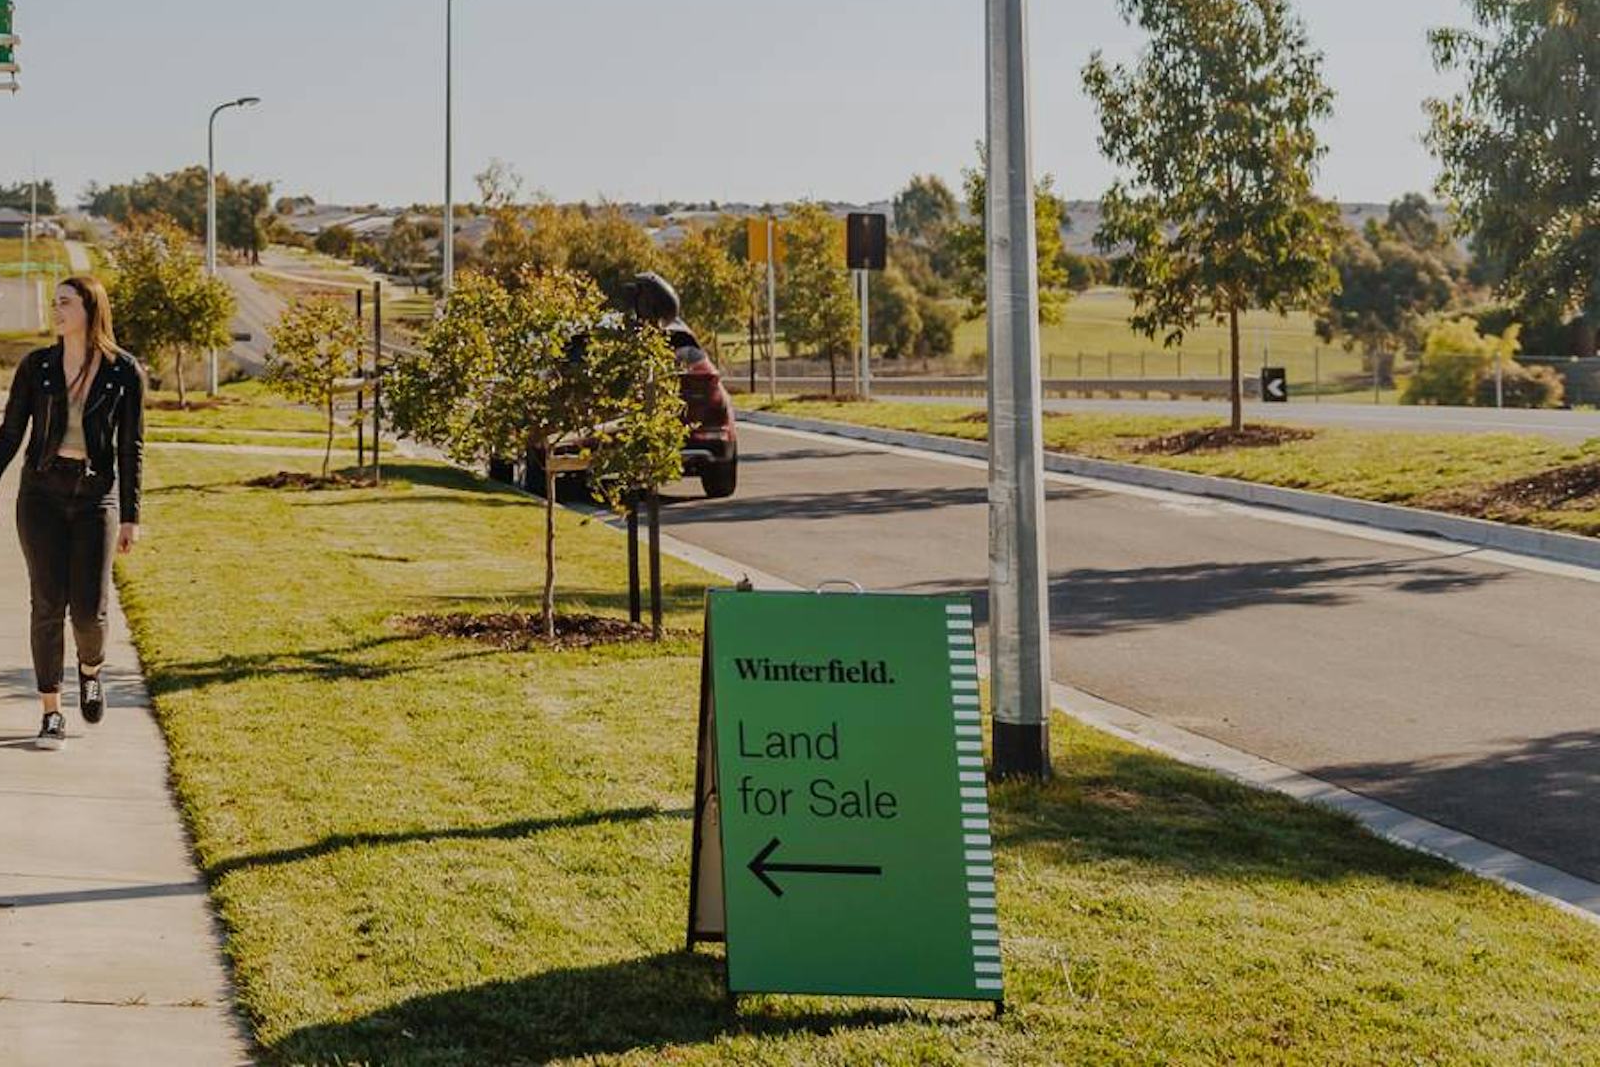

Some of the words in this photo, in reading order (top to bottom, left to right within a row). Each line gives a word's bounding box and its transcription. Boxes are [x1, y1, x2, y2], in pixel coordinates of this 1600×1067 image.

[734, 657, 896, 685] Winterfield.
[737, 719, 839, 761] Land
[737, 775, 793, 817] for
[808, 778, 898, 820] Sale
